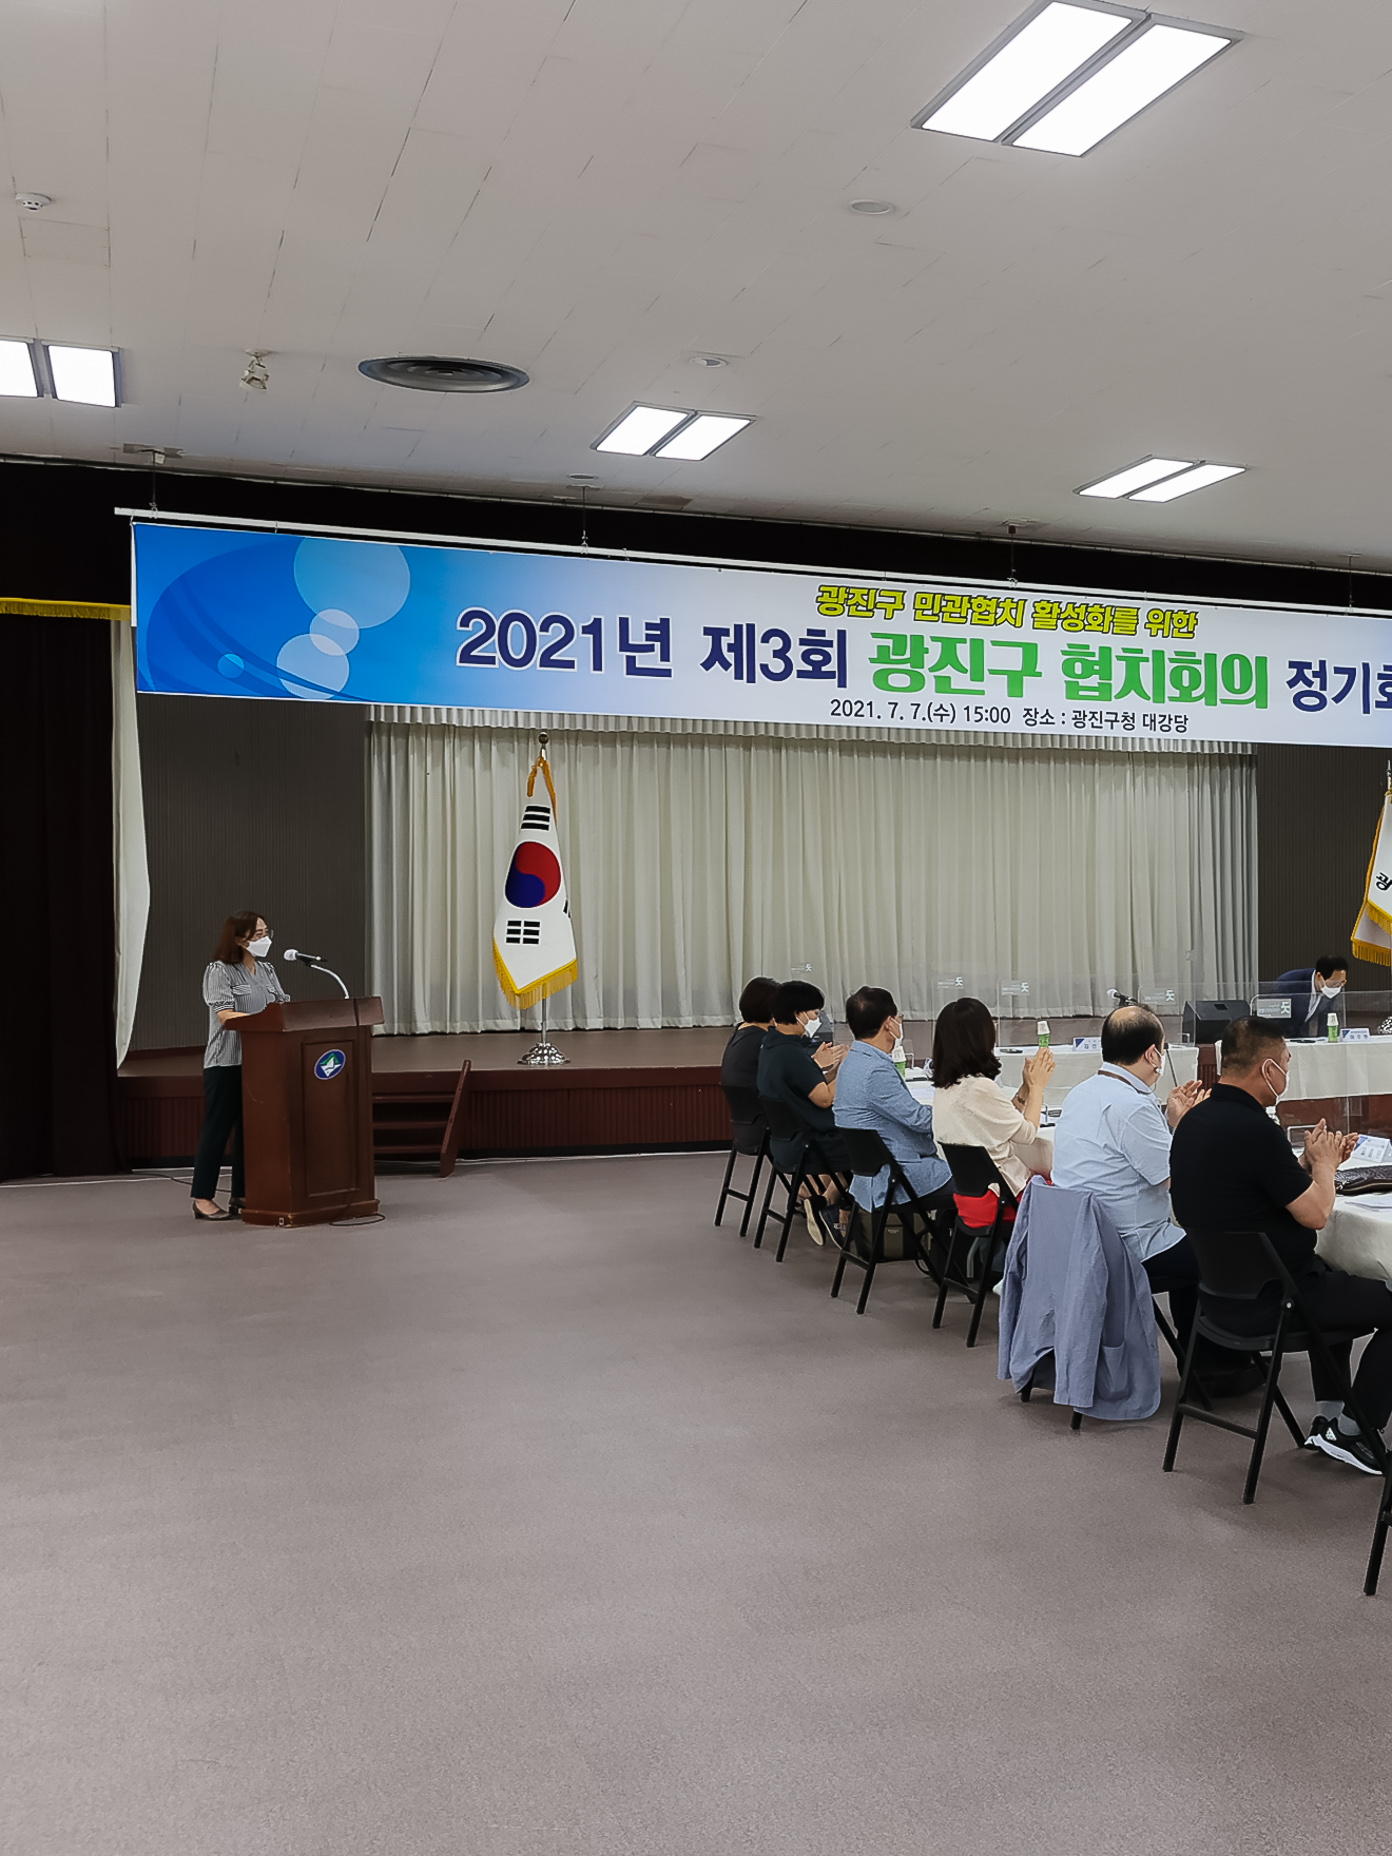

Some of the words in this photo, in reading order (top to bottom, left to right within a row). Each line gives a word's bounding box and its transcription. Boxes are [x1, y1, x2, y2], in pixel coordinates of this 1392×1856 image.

[816, 585, 907, 620] 광진구
[913, 592, 1028, 629] 민관협치
[1032, 600, 1140, 636] 활성화를
[1144, 608, 1198, 639] 위한
[458, 608, 673, 678] 2021년
[700, 622, 848, 689] 제3회
[868, 632, 1043, 698] 광진구
[1060, 643, 1269, 710] 협치회의
[830, 699, 882, 720] 2021.
[963, 705, 1011, 724] 15:00
[1022, 708, 1056, 726] 장소
[1072, 710, 1136, 731] 광진구청
[1143, 713, 1189, 733] 대강당
